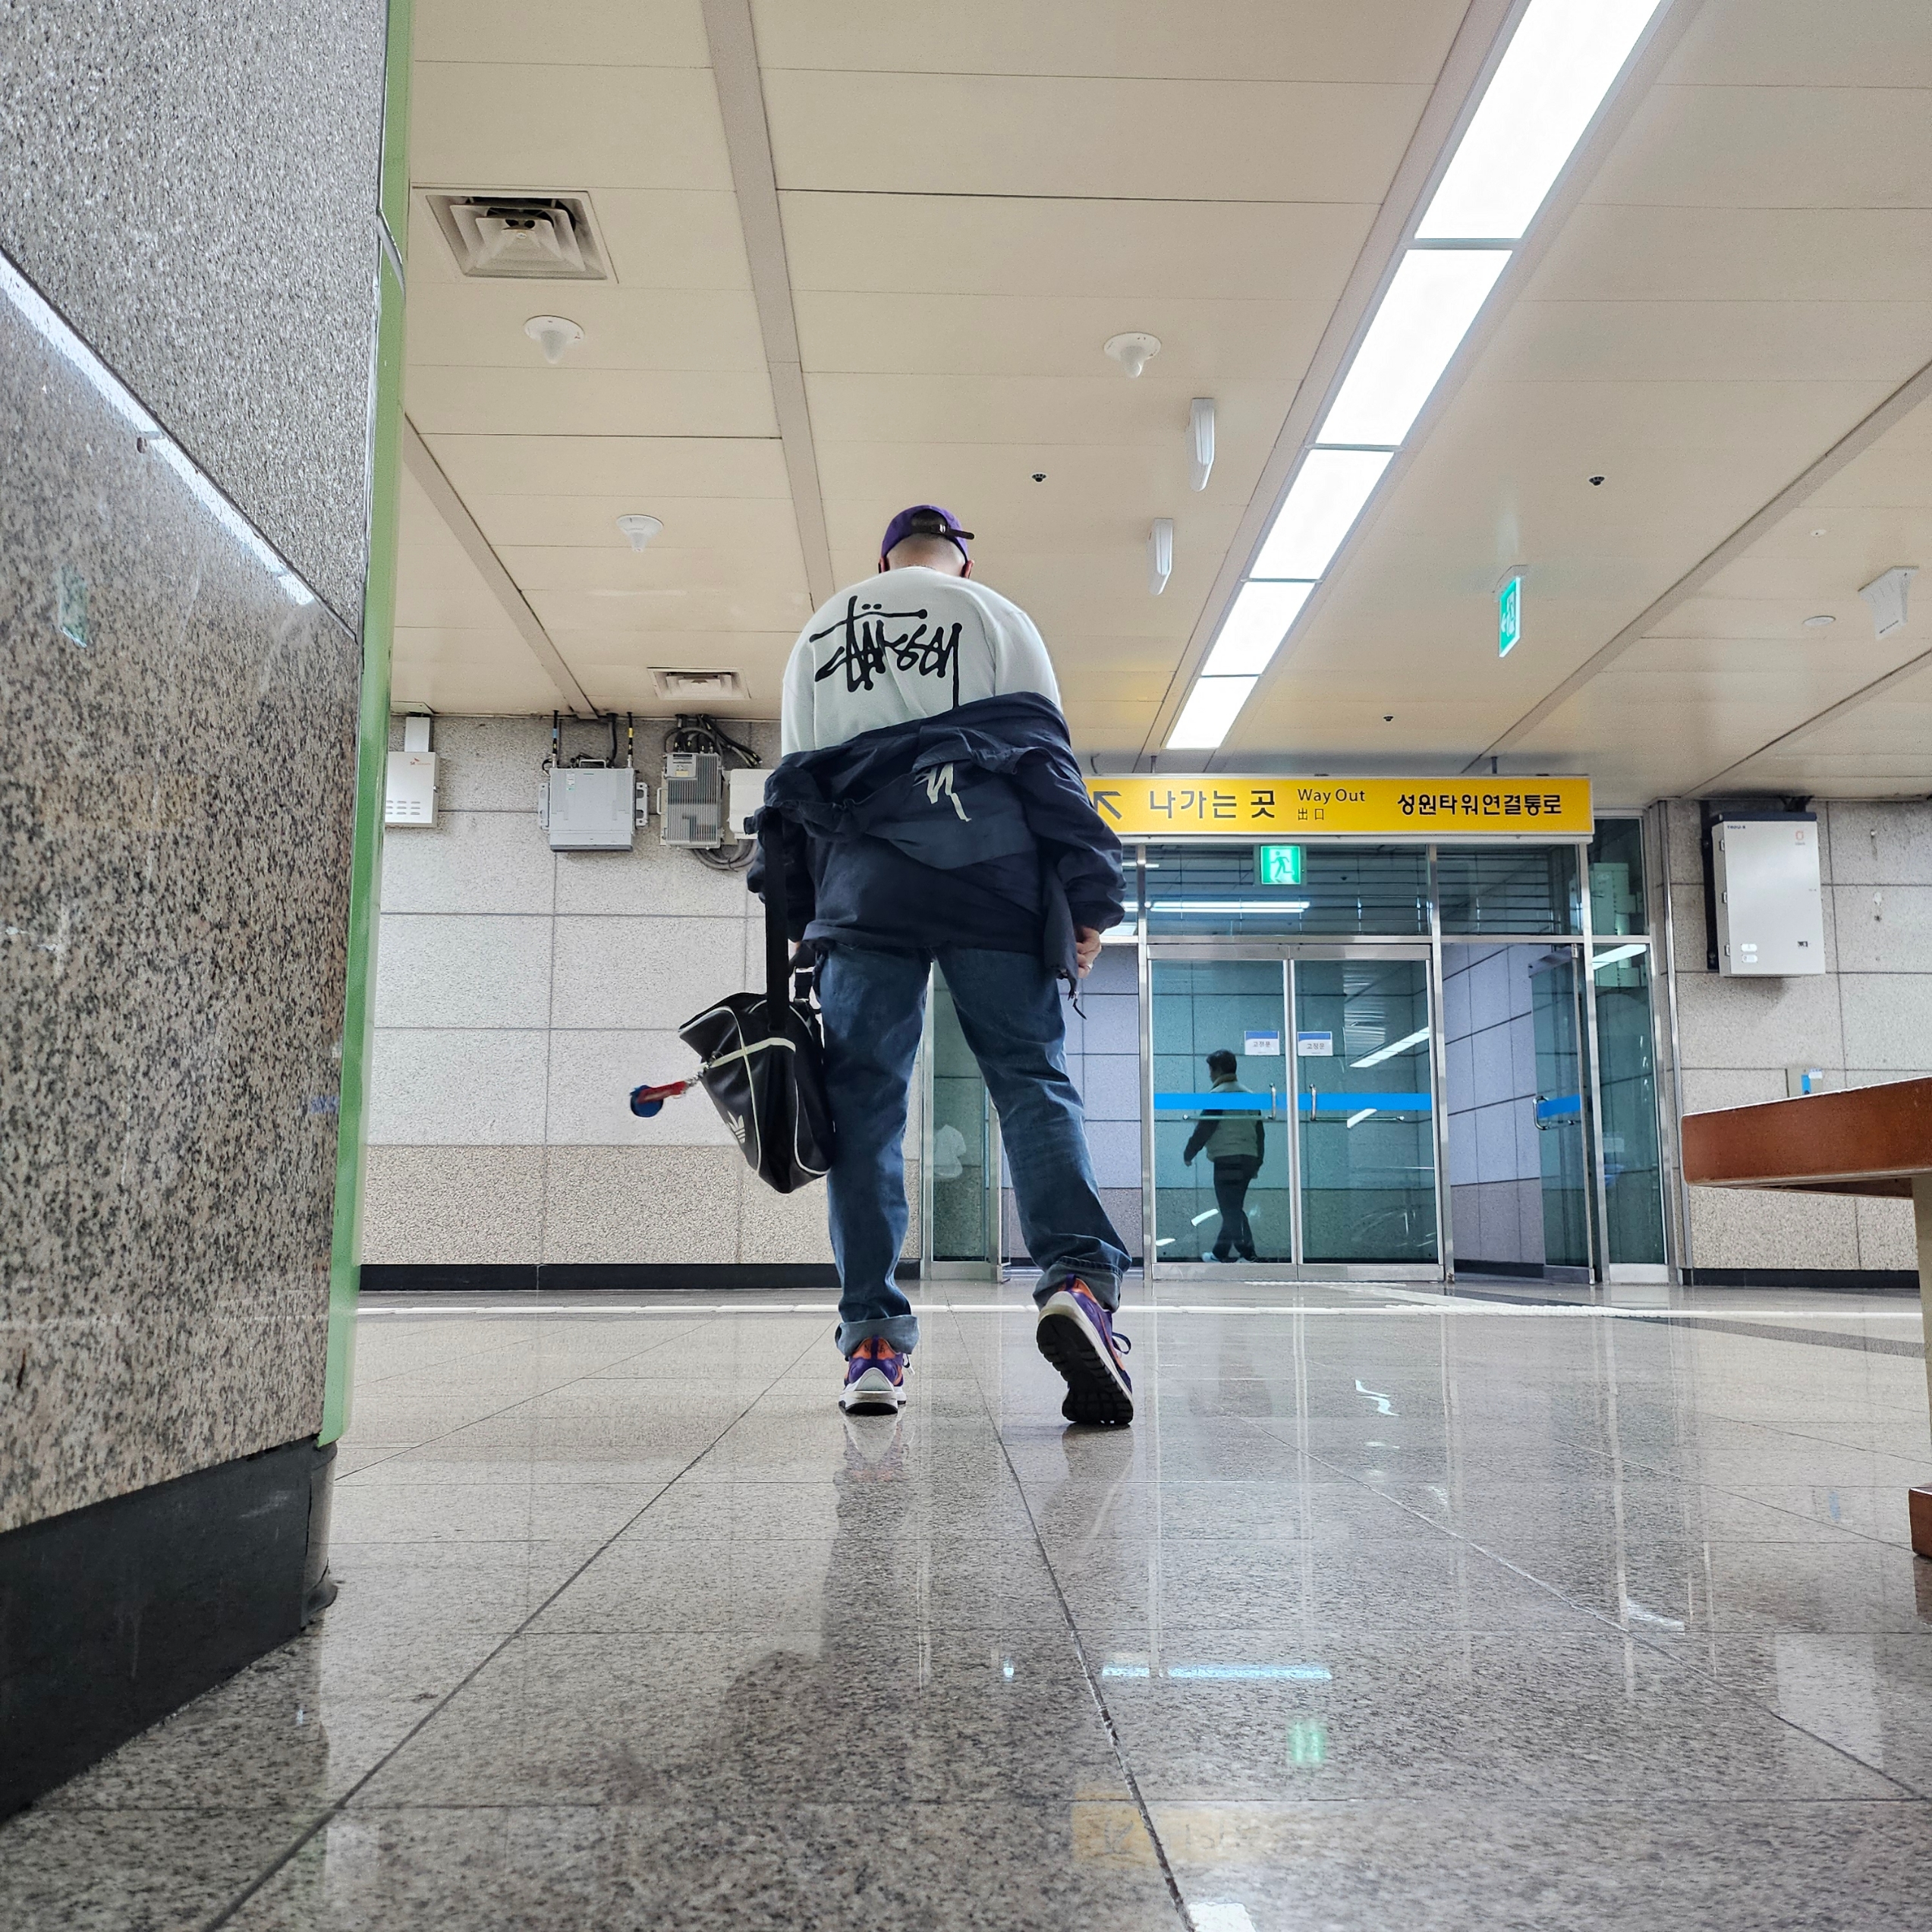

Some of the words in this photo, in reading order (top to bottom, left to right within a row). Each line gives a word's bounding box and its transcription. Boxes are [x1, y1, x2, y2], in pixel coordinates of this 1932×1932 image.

[1149, 790, 1238, 819] 나가는
[1250, 790, 1276, 819] 곳
[1297, 788, 1331, 804] Way
[1335, 788, 1366, 802] Out
[1397, 793, 1562, 817] 성원타워연결통로
[1297, 807, 1325, 820] 出口
